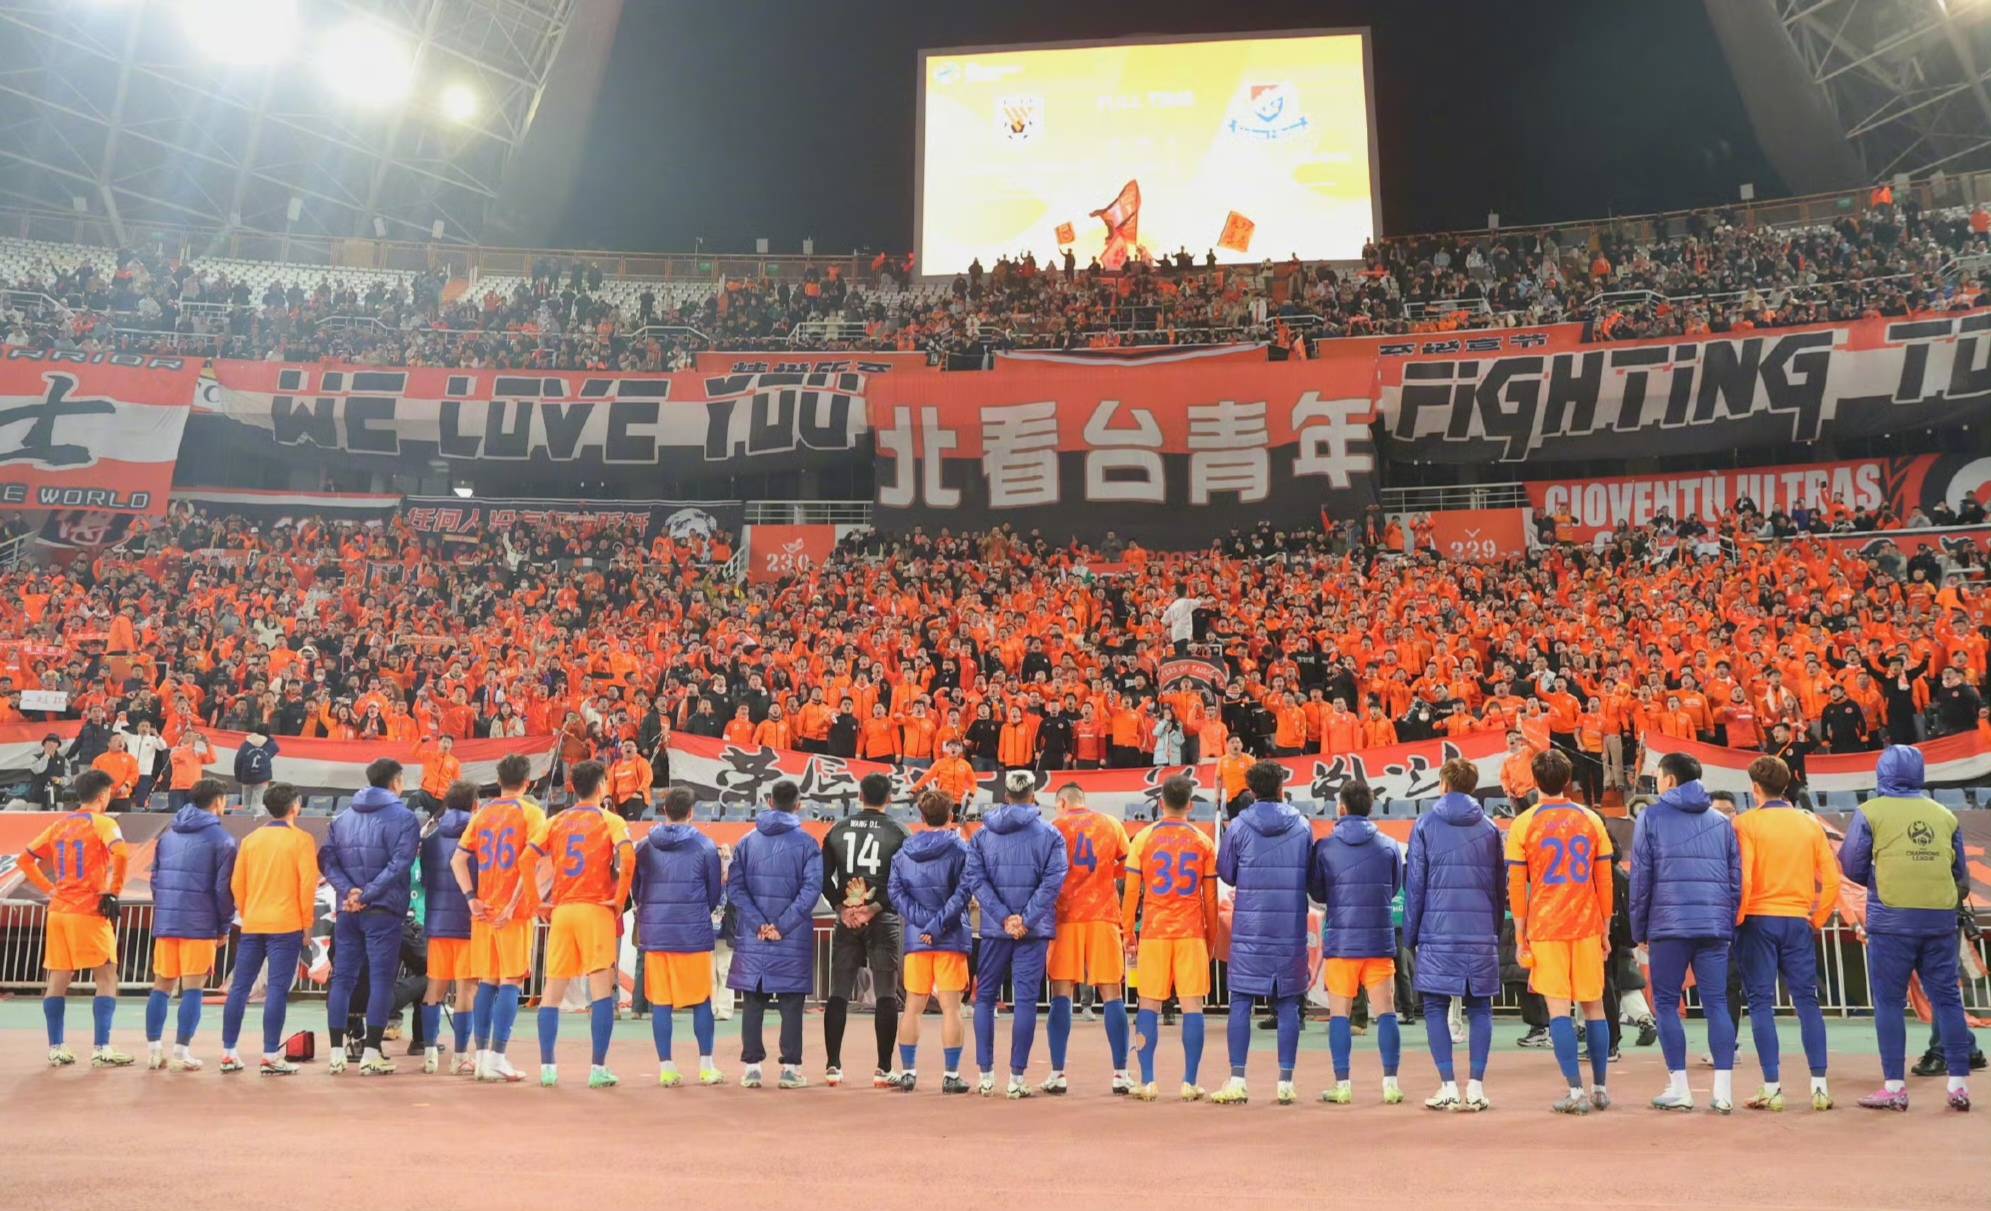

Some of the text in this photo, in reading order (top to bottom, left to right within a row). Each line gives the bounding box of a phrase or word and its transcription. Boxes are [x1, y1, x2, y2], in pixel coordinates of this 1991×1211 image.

[272, 368, 868, 465] WE LOVE YOU
[1395, 330, 1847, 462] FIGHTING
[878, 391, 1375, 509] 北看台青年
[41, 487, 149, 508] WORLD
[850, 819, 868, 828] WANG
[56, 840, 85, 881] 11
[478, 827, 516, 872] 36
[564, 834, 586, 878] 5
[843, 831, 881, 875] 14
[1073, 831, 1097, 873] 4
[1541, 834, 1591, 885] 28
[1152, 851, 1200, 897] 35
